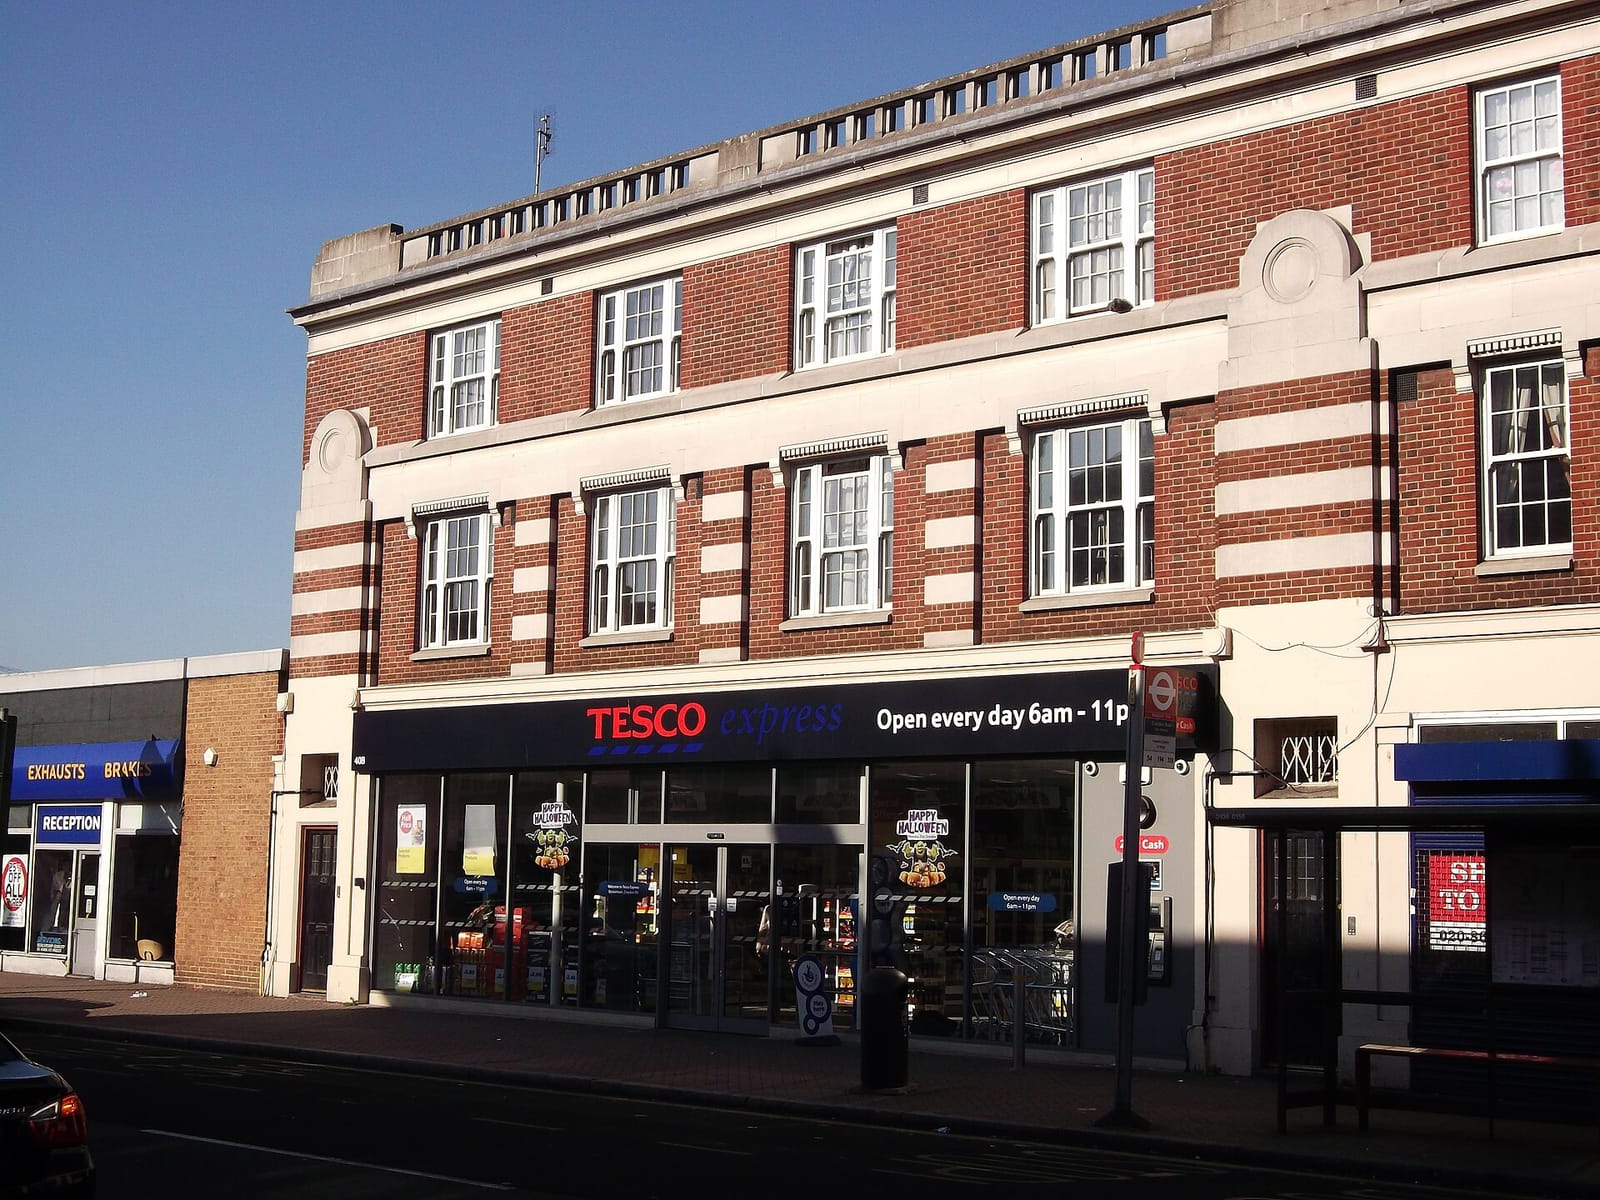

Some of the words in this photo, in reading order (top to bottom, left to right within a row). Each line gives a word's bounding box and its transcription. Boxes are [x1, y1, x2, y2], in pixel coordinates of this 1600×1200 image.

[1177, 677, 1198, 689] SCO
[877, 708, 927, 734] Open
[931, 710, 984, 732] every
[988, 704, 1025, 730] day
[1028, 702, 1073, 724] 6am
[1091, 698, 1129, 726] 11p
[586, 702, 706, 739] TESCO
[719, 702, 843, 745] express
[1180, 720, 1193, 729] Cash
[28, 763, 86, 780] EXHAUSTS
[104, 760, 152, 779] BRAKES
[542, 803, 563, 812] HAPPY
[534, 813, 571, 824] HALLOWEEN
[909, 810, 936, 821] HAPPY
[43, 815, 101, 831] RECEPTION
[898, 822, 948, 834] HALLOWEEN
[1141, 839, 1165, 850] Cash
[9, 872, 21, 883] OFF
[1450, 862, 1486, 883] SH
[5, 883, 23, 898] ALL
[1003, 893, 1017, 901] Open
[1439, 888, 1480, 910] TO
[1022, 903, 1037, 911] 11pm
